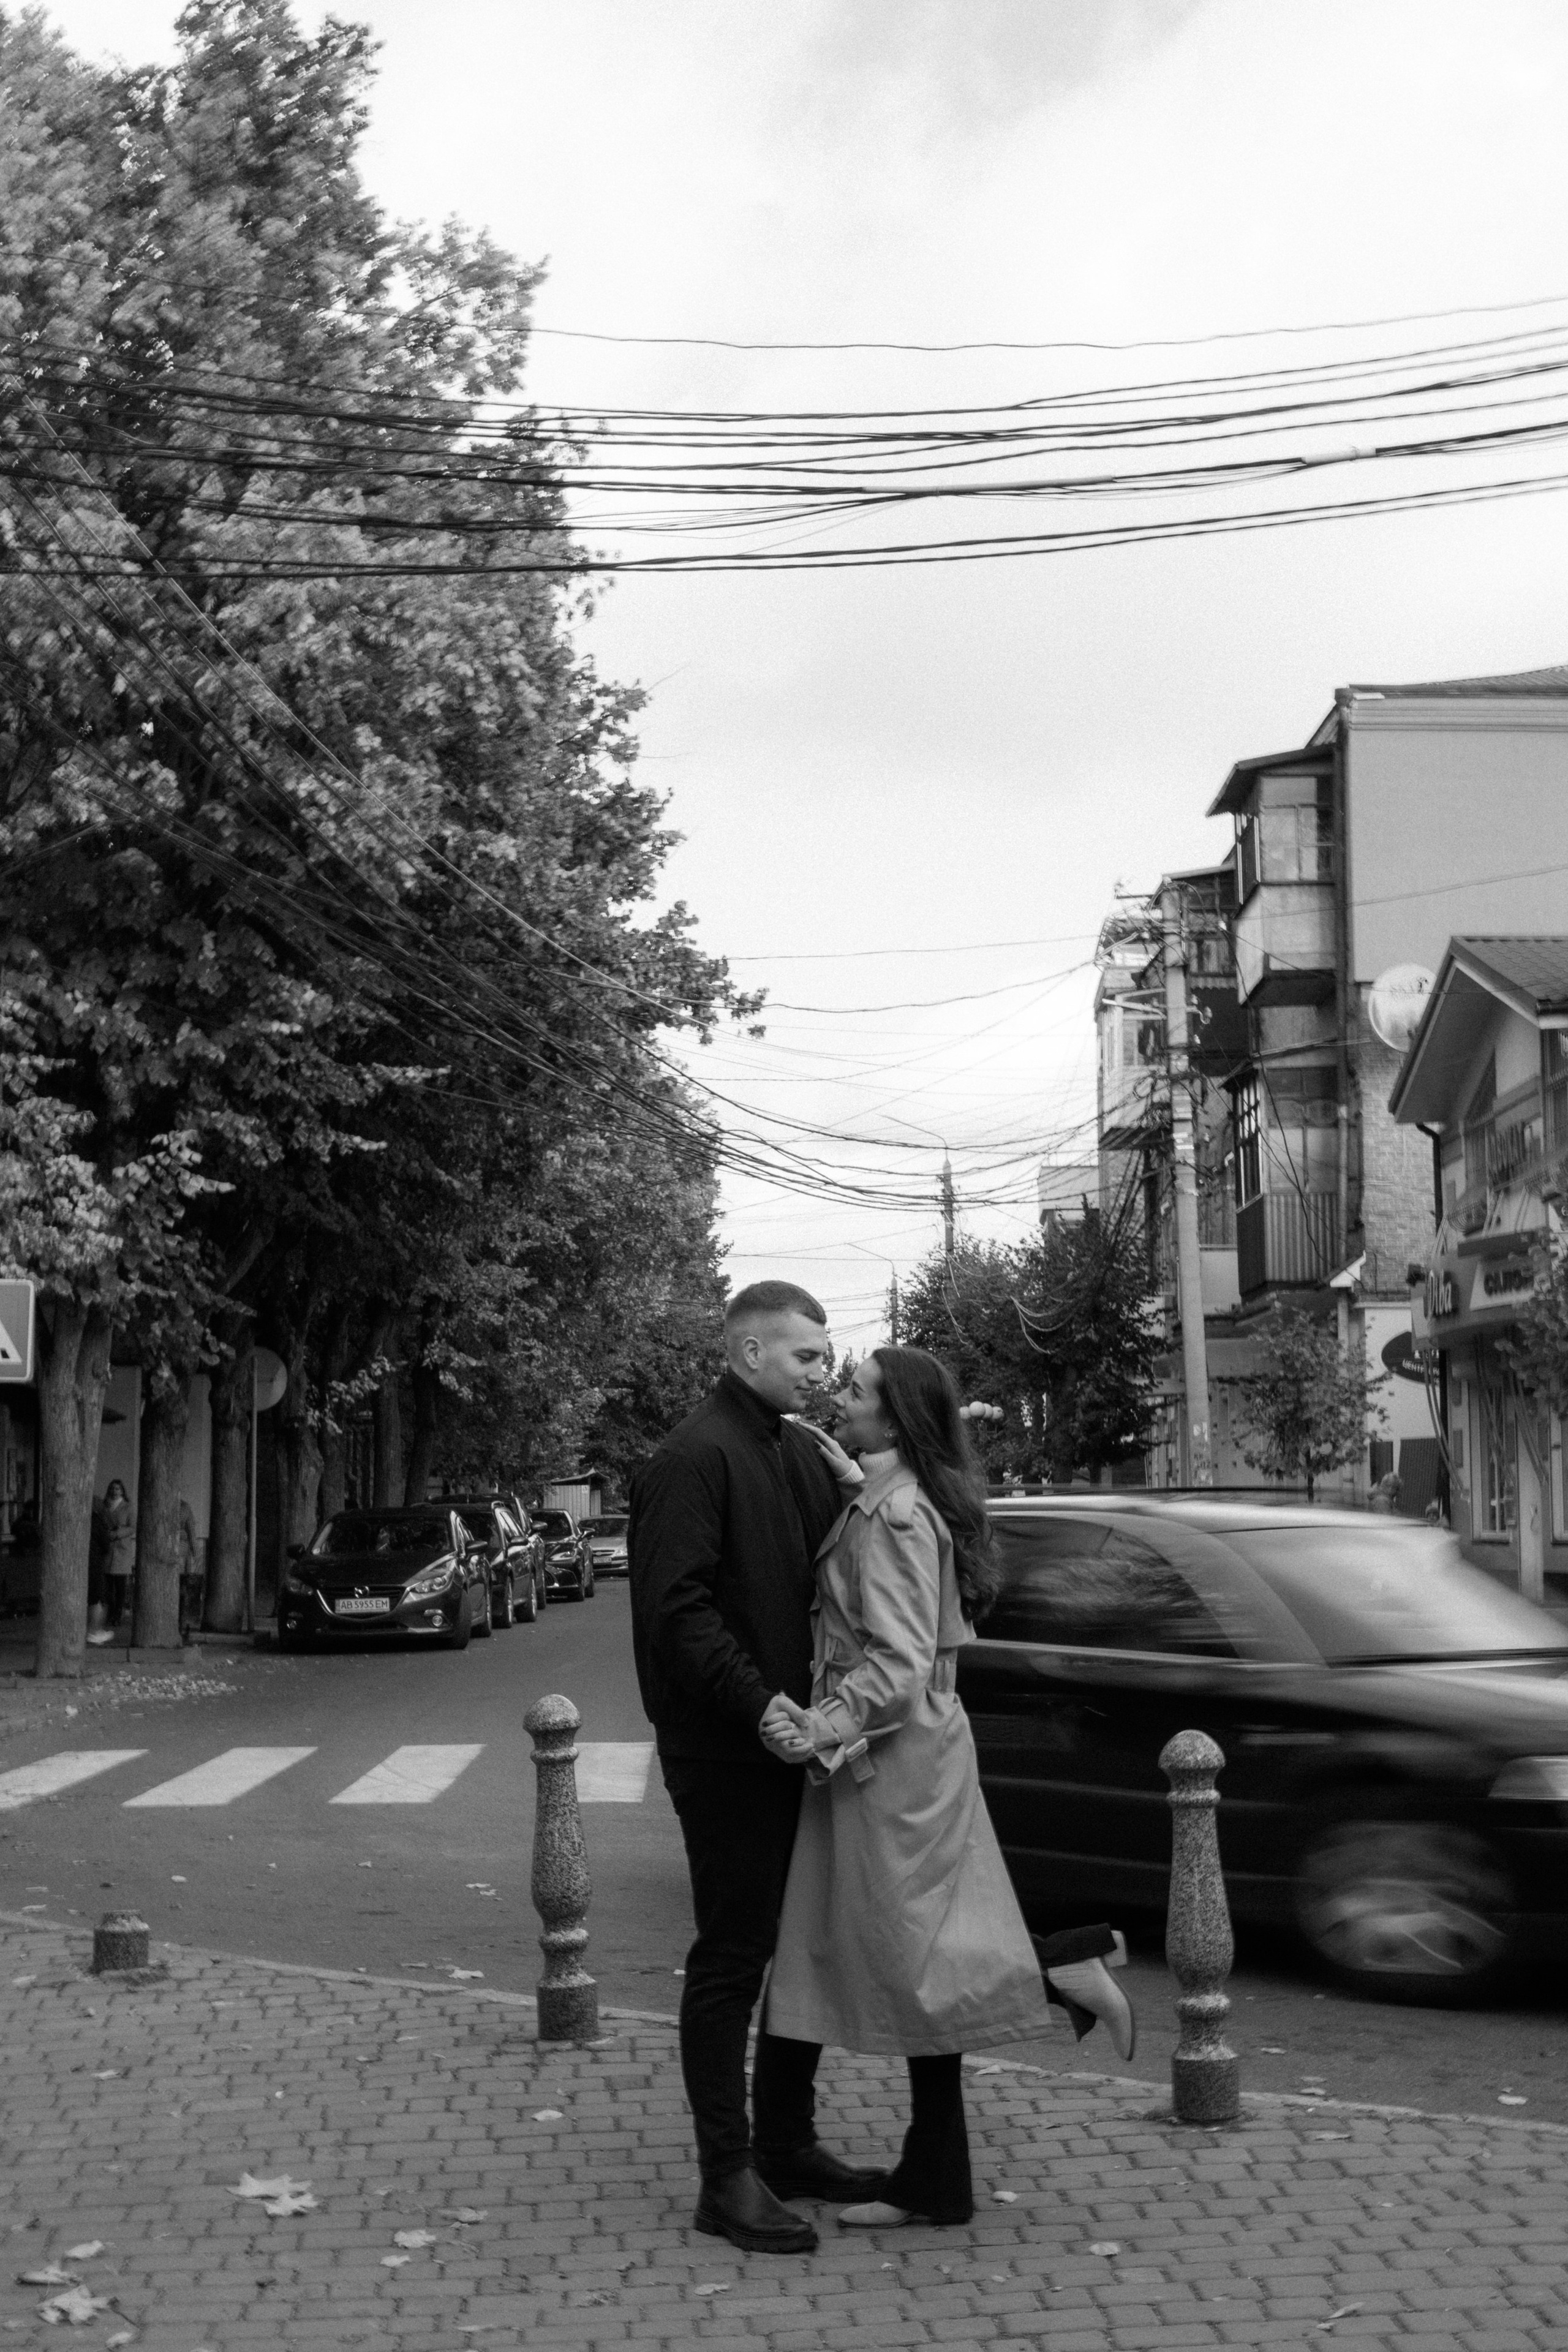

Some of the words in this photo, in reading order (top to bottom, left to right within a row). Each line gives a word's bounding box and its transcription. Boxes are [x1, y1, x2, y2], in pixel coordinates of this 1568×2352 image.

[341, 1600, 353, 1609] AB
[355, 1600, 374, 1608] 5955
[375, 1599, 388, 1608] EM
